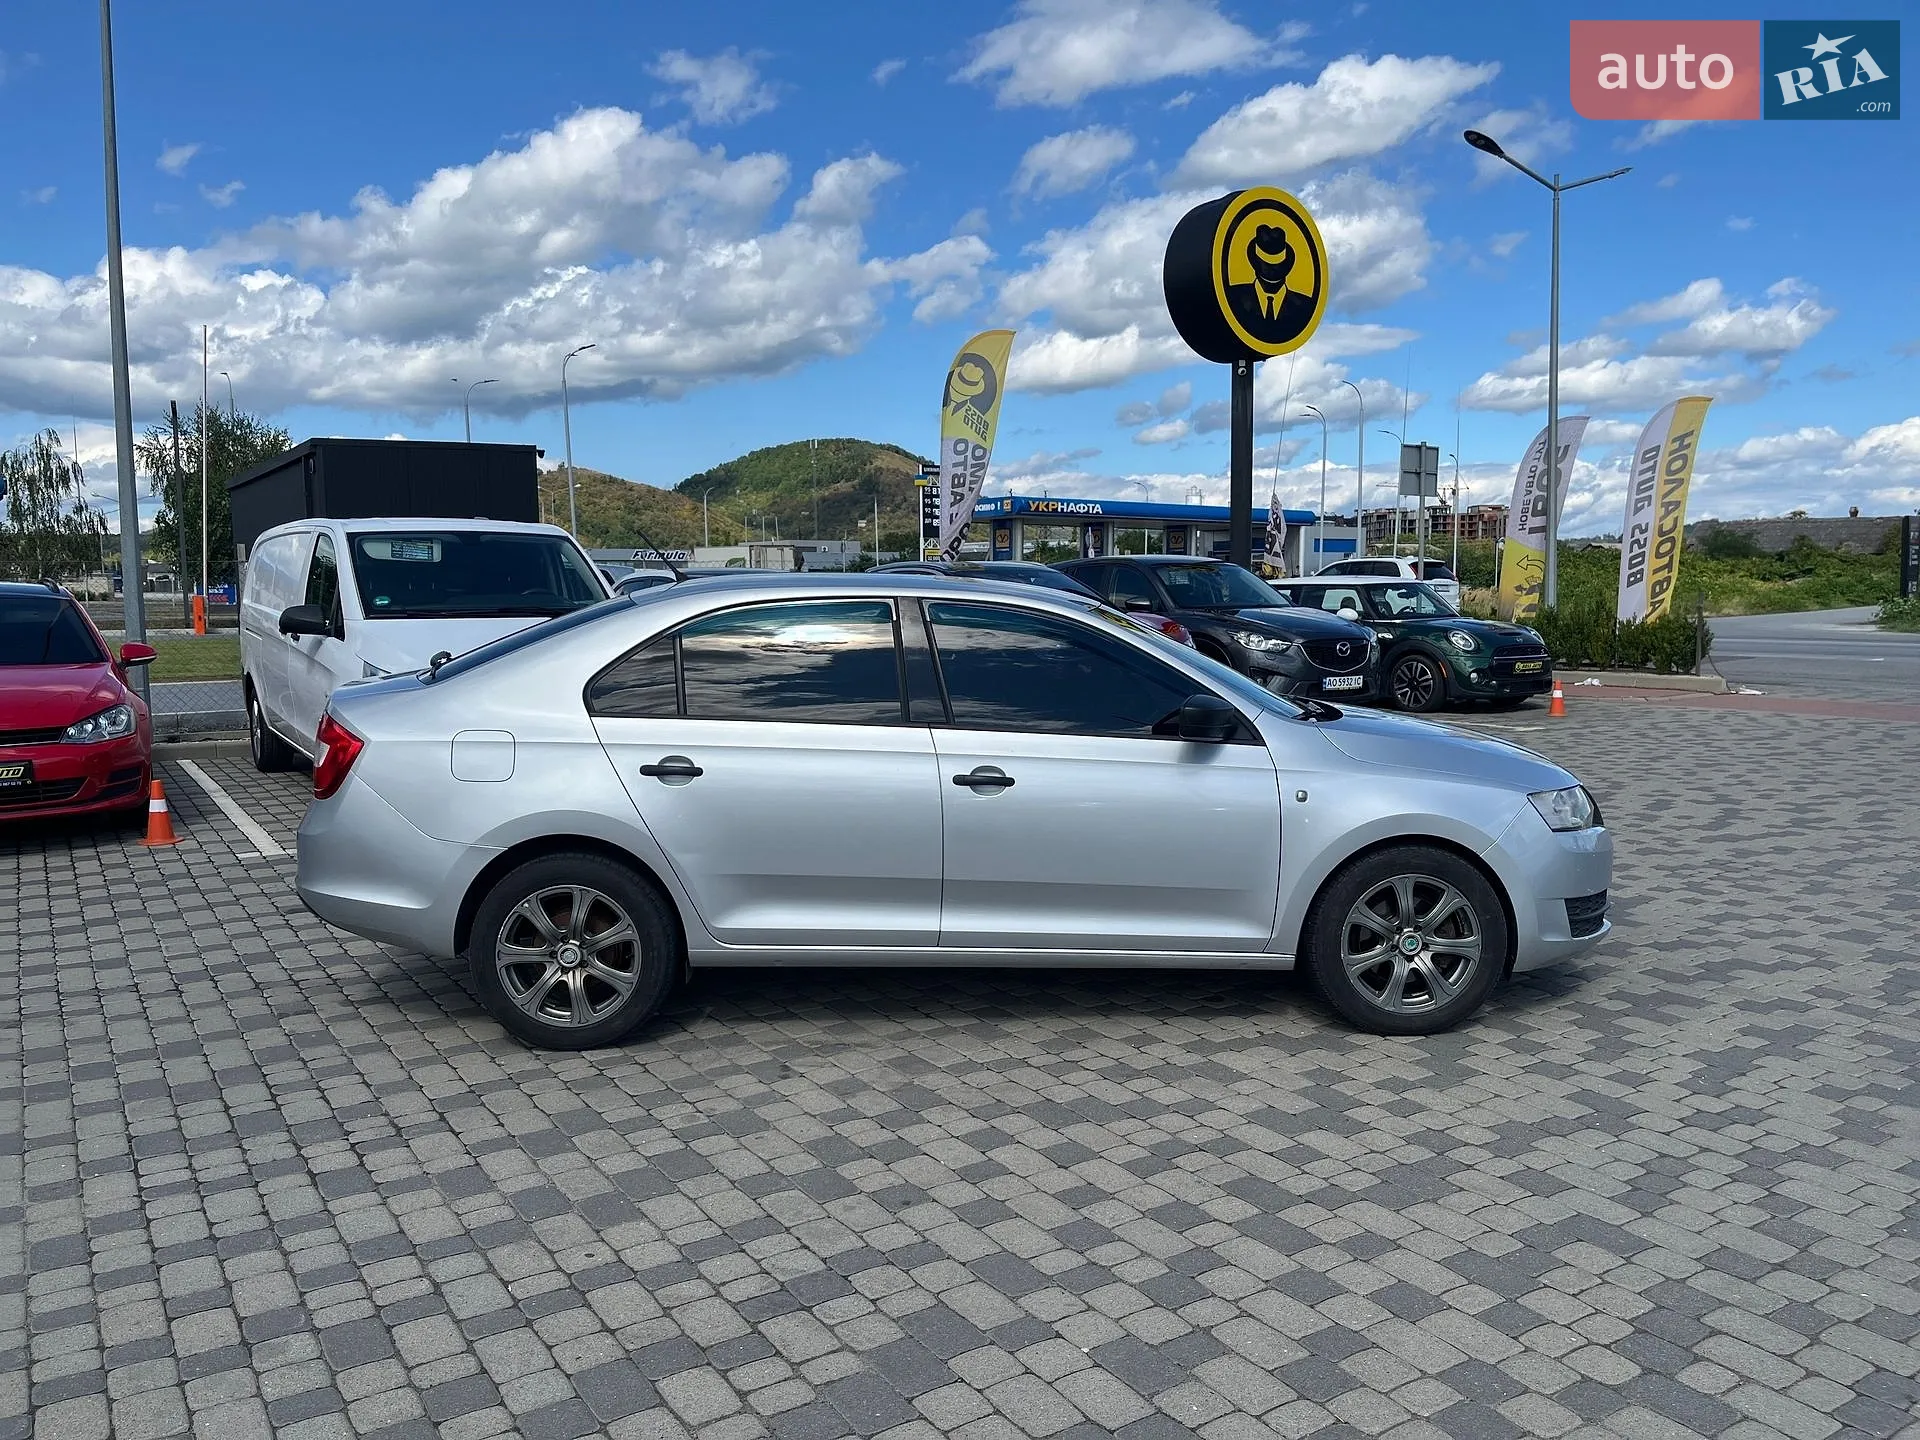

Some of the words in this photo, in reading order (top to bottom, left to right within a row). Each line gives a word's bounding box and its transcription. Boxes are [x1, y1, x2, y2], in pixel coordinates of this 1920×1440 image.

[974, 503, 995, 512] ОСИМО
[1028, 500, 1103, 514] УКРНАФТА
[633, 550, 687, 561] Formula
[1326, 678, 1337, 687] AO
[1338, 677, 1353, 687] 5932
